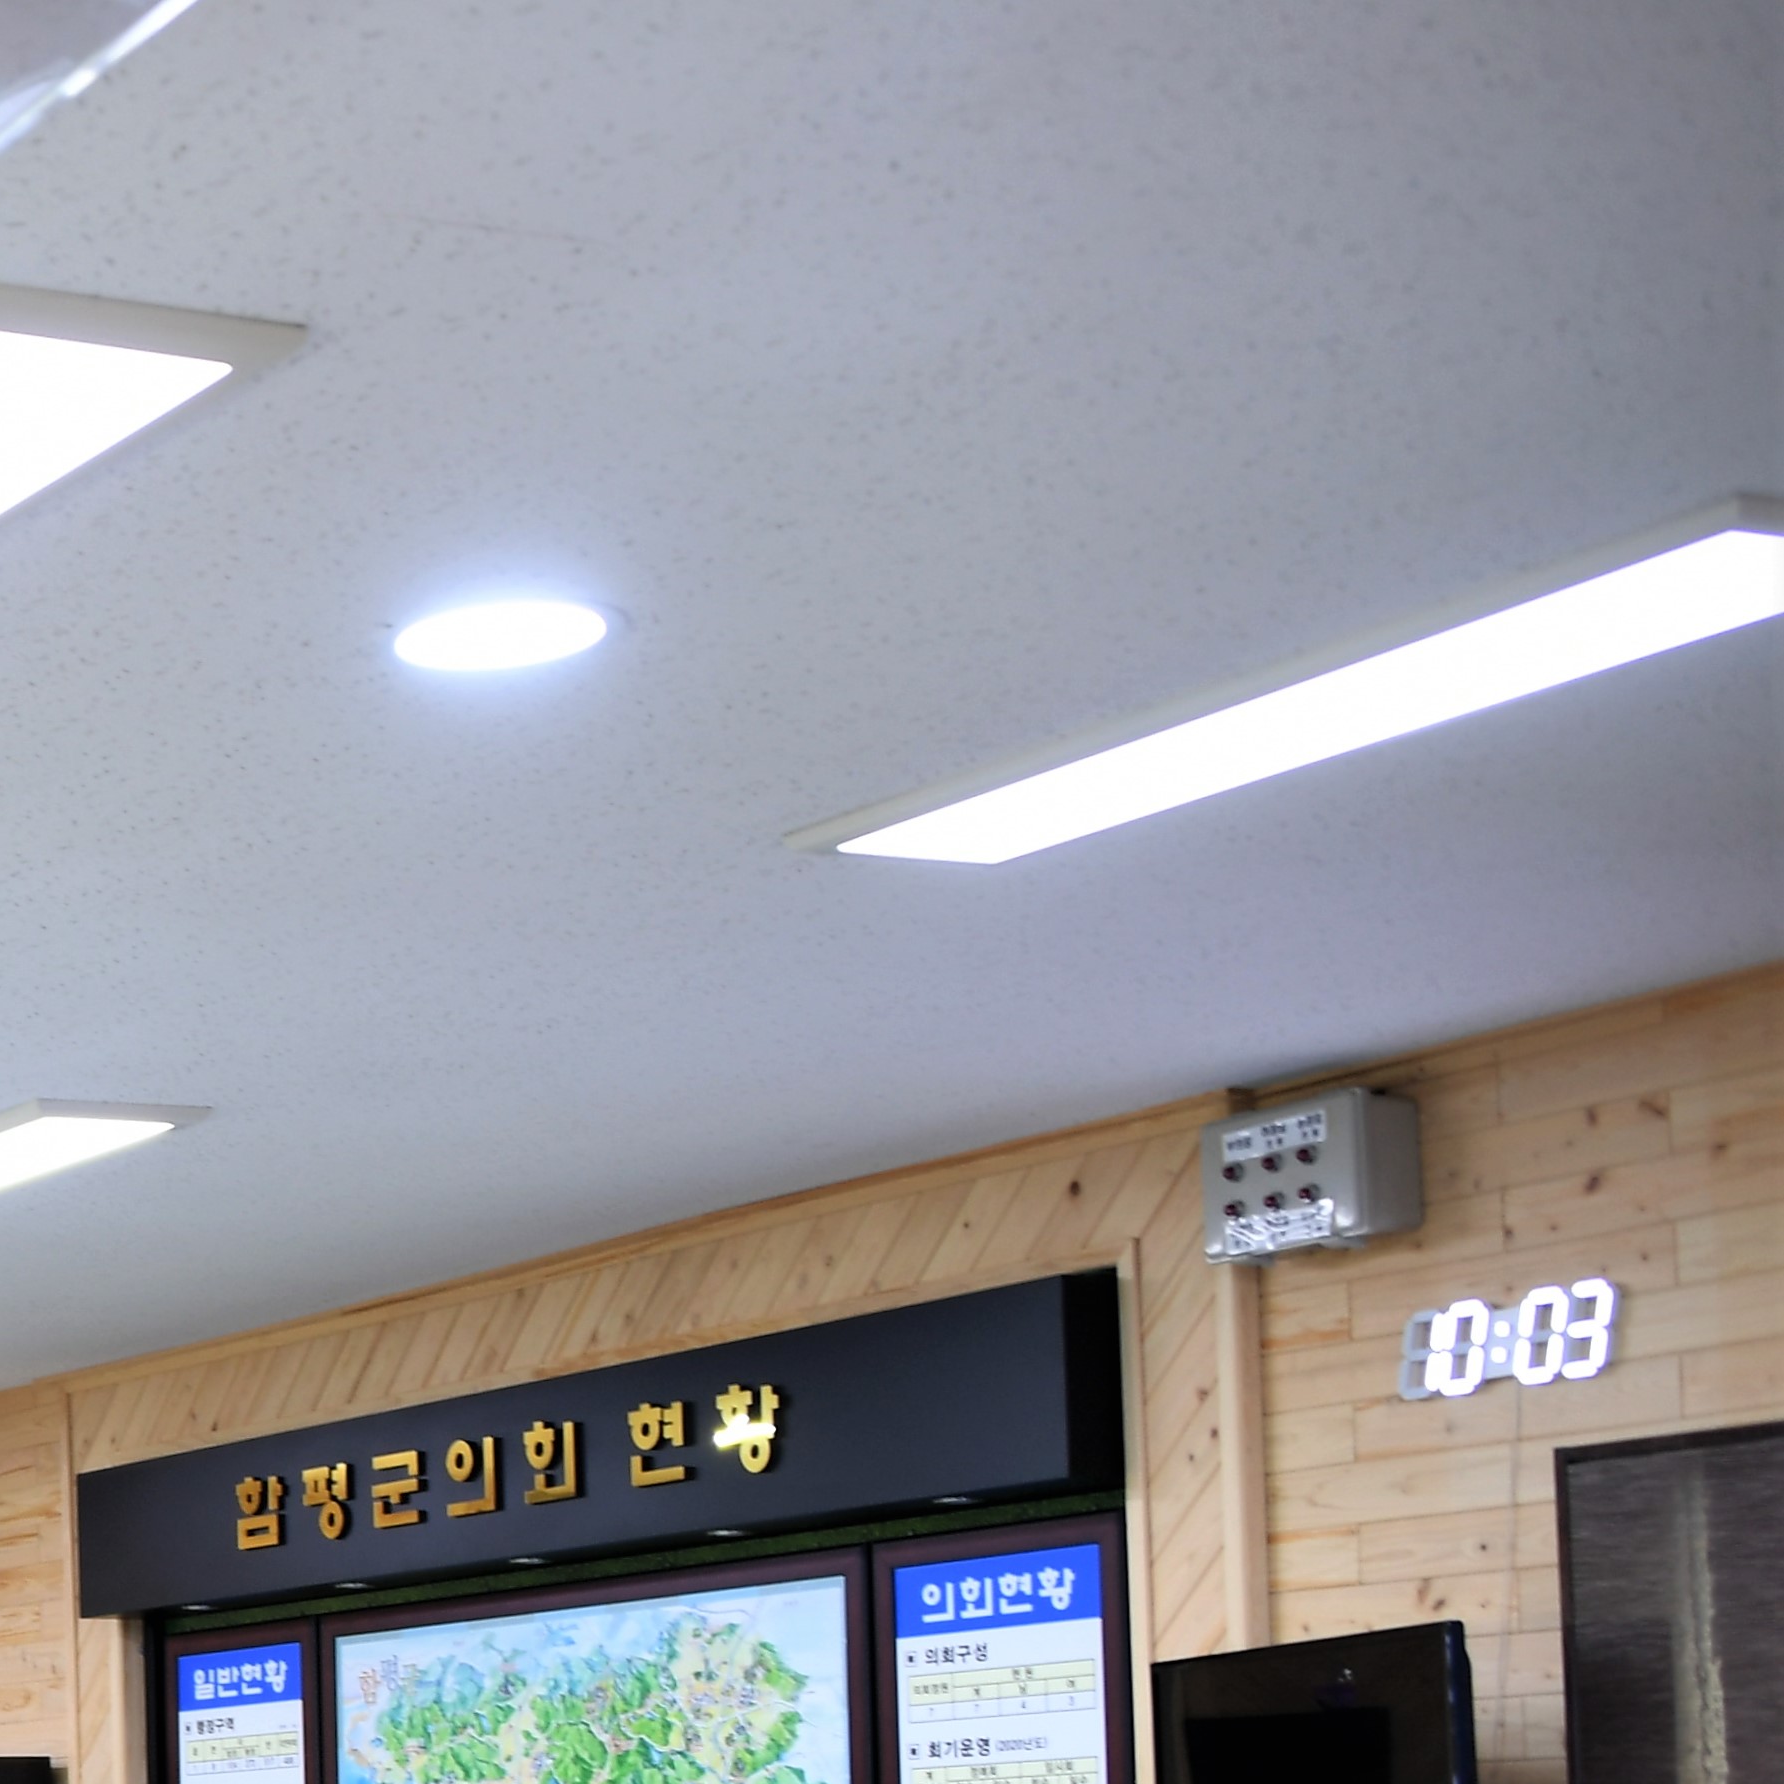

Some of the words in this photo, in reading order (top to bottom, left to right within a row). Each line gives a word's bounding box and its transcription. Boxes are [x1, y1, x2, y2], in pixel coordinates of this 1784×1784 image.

[235, 1420, 577, 1551] 함평군의회
[627, 1383, 780, 1488] 현황
[921, 1567, 1076, 1624] 의회현황
[925, 1642, 988, 1665] 의회구성
[193, 1658, 289, 1701] 일반현황
[928, 1738, 990, 1759] 회기운영
